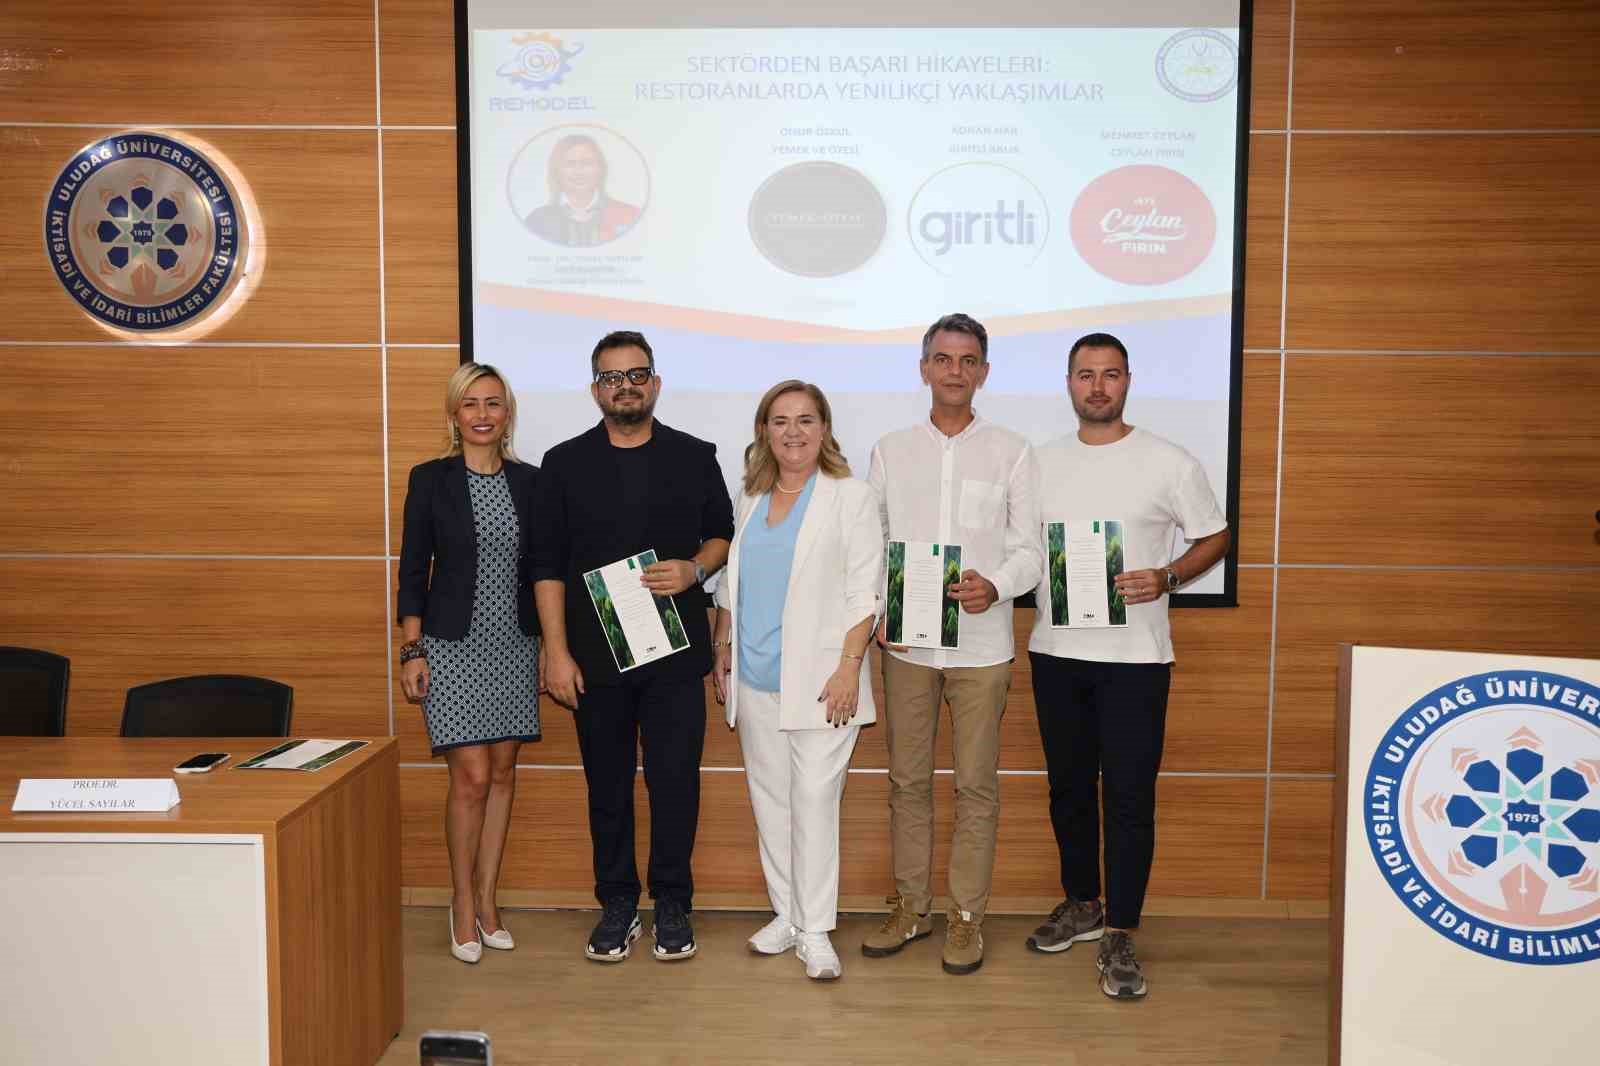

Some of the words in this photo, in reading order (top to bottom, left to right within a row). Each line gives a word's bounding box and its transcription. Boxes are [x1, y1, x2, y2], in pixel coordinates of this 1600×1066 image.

[687, 50, 821, 73] SEKTÖRDEN
[828, 55, 908, 78] BAŞARI
[488, 97, 596, 111] REMODEL
[634, 81, 830, 101] RESTORANLARDA
[835, 80, 940, 104] YENİLİKÇİ
[948, 81, 1105, 104] YAKLAŞIMLAR
[58, 145, 113, 201] ULUDAĞ
[116, 138, 225, 203] ÜNİVERSİTESİ
[133, 228, 152, 238] 1975
[919, 199, 1035, 256] giritli
[1099, 207, 1185, 234] Ceylan
[1120, 242, 1169, 255] FIRIN
[51, 209, 78, 279] İKTİSADİ
[73, 279, 92, 299] VE
[91, 297, 133, 323] İDARİ
[136, 293, 206, 325] BİLİMLER
[1384, 684, 1477, 764] ULUDAĞ
[1485, 677, 1600, 721] ÜNİVER
[1506, 812, 1540, 825] 1975
[1371, 774, 1412, 876] İKTİSADİ
[1402, 878, 1433, 909] VE
[1430, 903, 1501, 951] İDARİ
